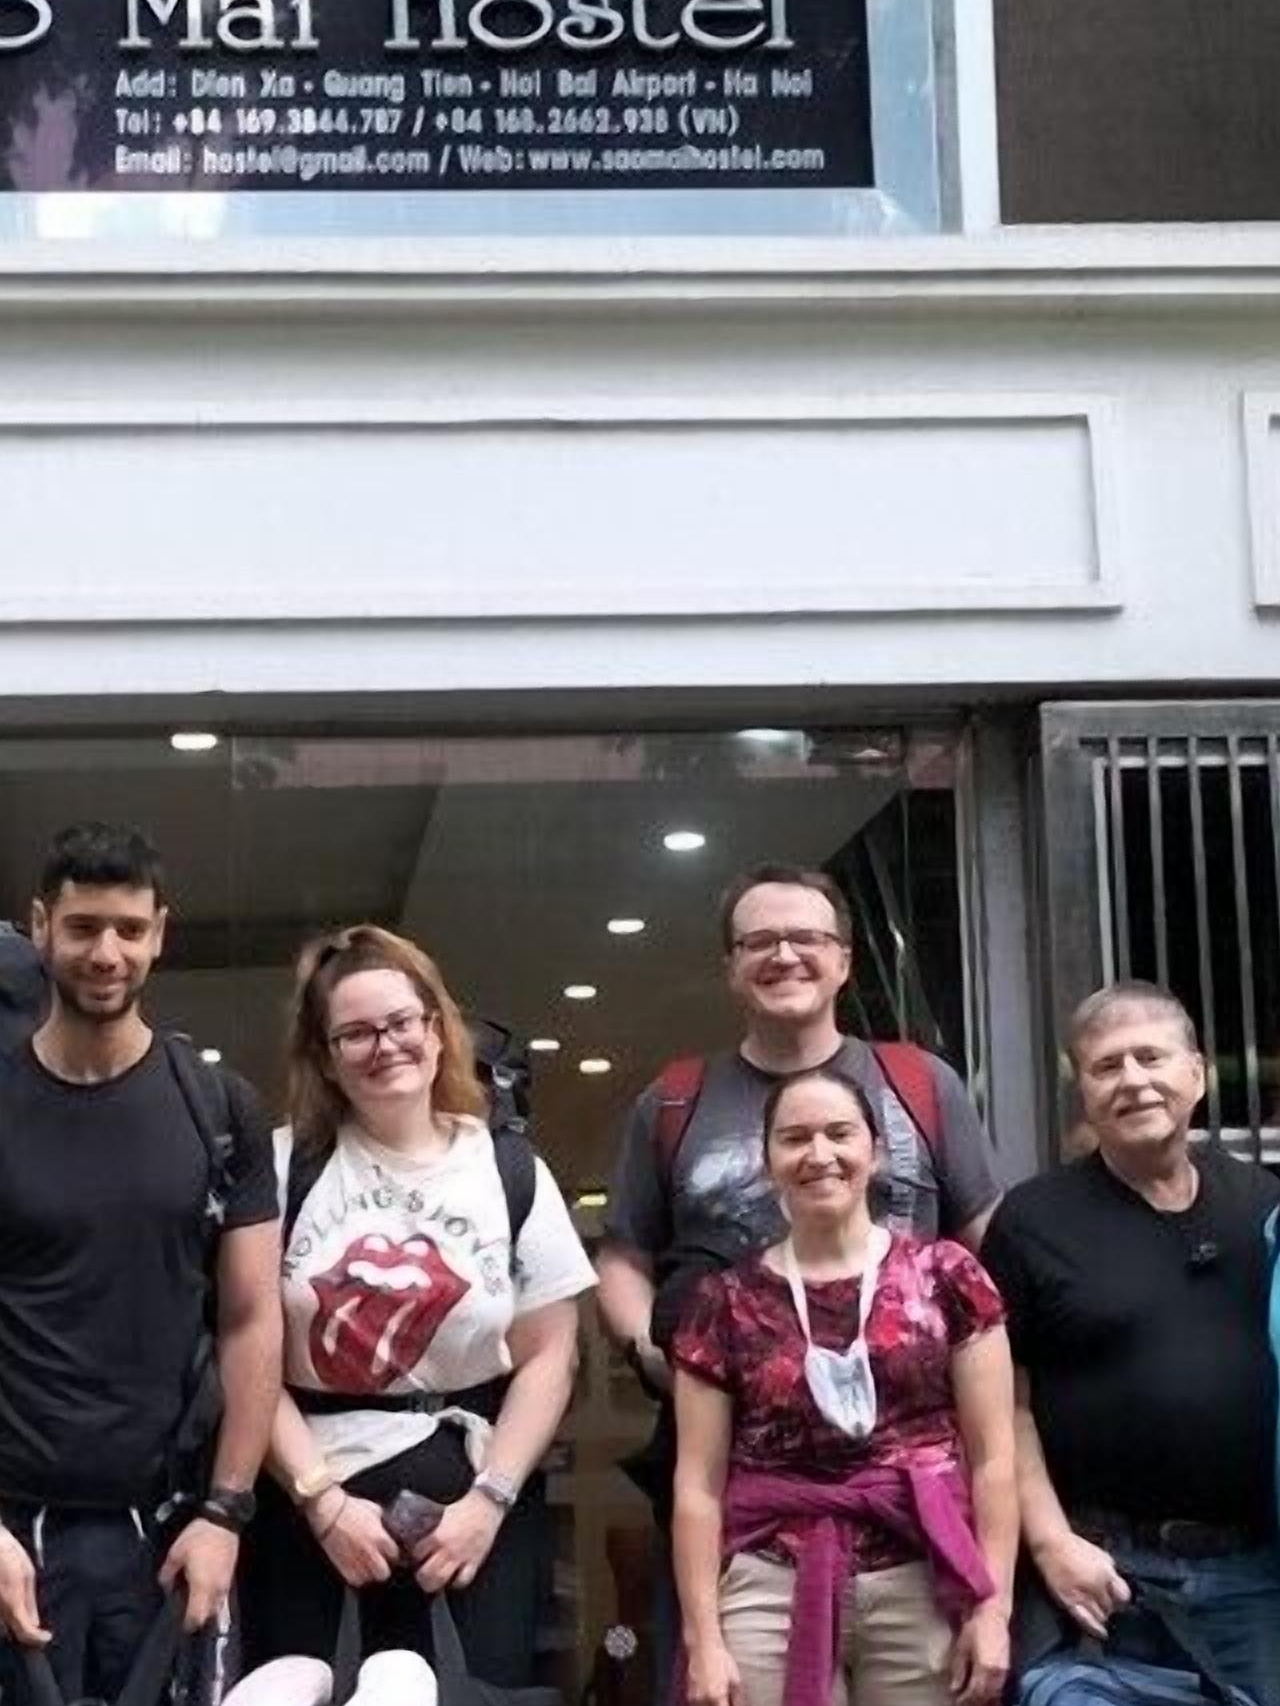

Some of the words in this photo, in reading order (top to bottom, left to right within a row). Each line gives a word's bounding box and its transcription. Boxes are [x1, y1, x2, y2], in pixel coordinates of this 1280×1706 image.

[115, 70, 177, 97] Add:
[191, 69, 246, 97] Dien
[324, 69, 405, 104] Quang
[421, 68, 472, 97] Tien
[500, 68, 541, 96] Noi
[557, 68, 597, 96] Bai
[612, 68, 696, 102] Airport
[771, 68, 813, 96] Noi
[115, 107, 161, 134] Tel:
[115, 144, 192, 174] Email:
